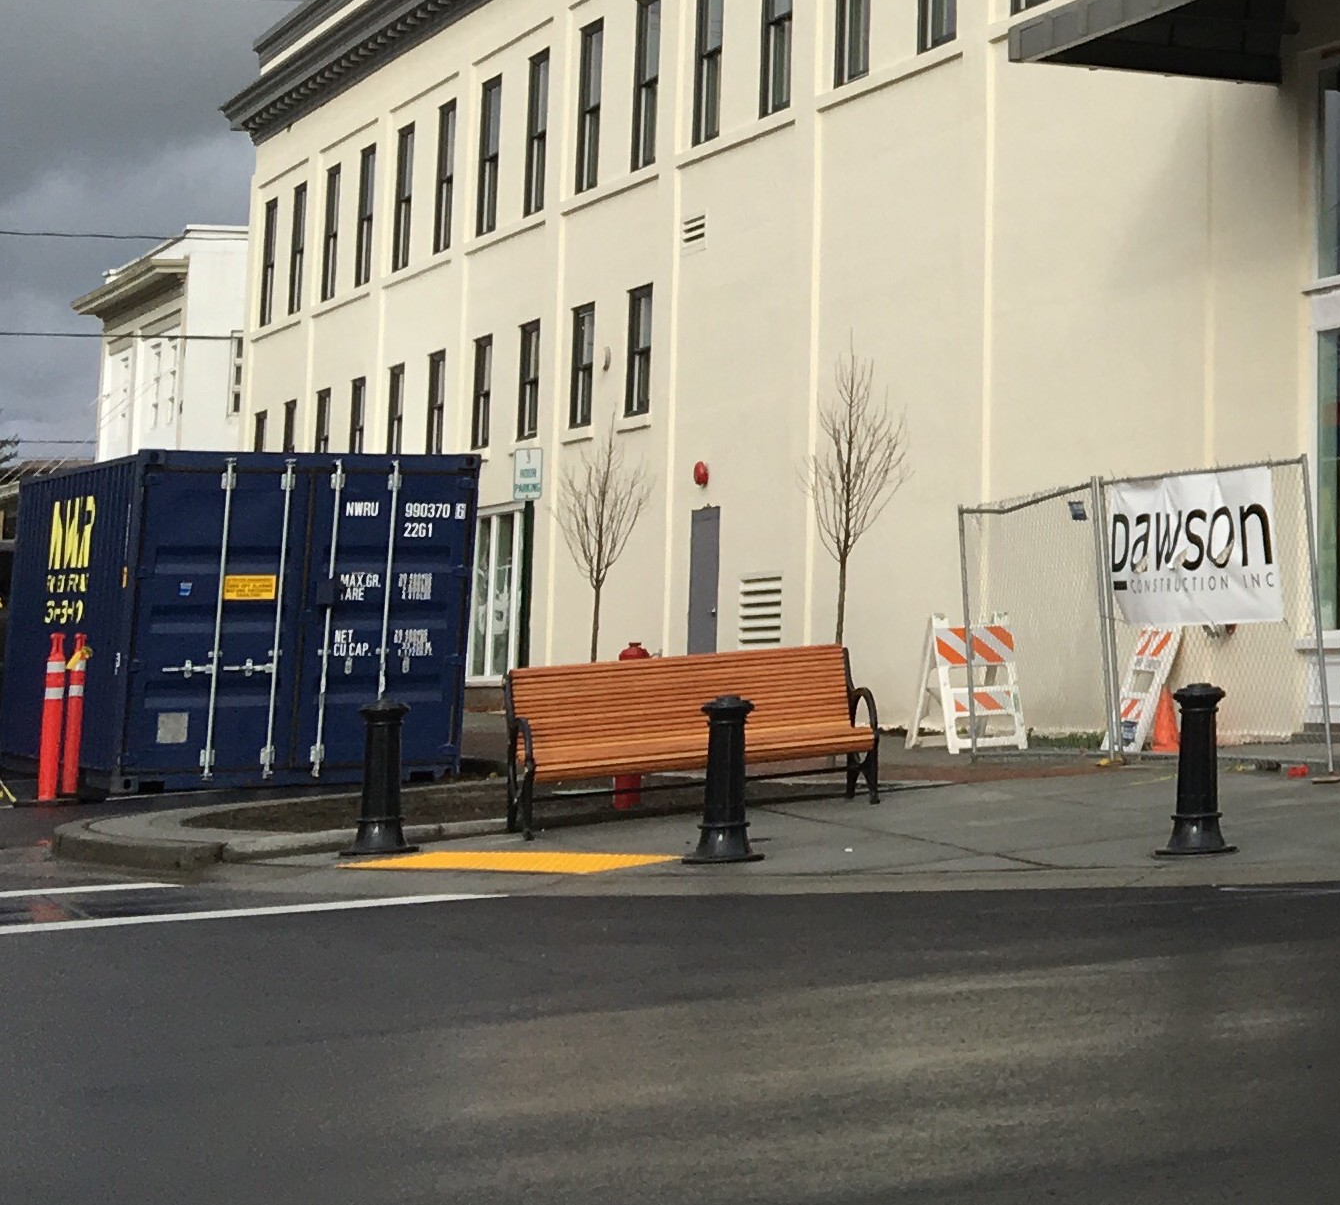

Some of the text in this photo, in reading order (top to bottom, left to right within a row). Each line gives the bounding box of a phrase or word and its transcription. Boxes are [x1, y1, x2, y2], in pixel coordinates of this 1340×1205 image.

[345, 501, 379, 516] NWRU
[404, 502, 451, 518] 990370
[403, 522, 433, 537] 22G1
[1130, 572, 1275, 594] CONSTRUCTION INC
[341, 587, 365, 601] ARE
[334, 629, 354, 644] NET
